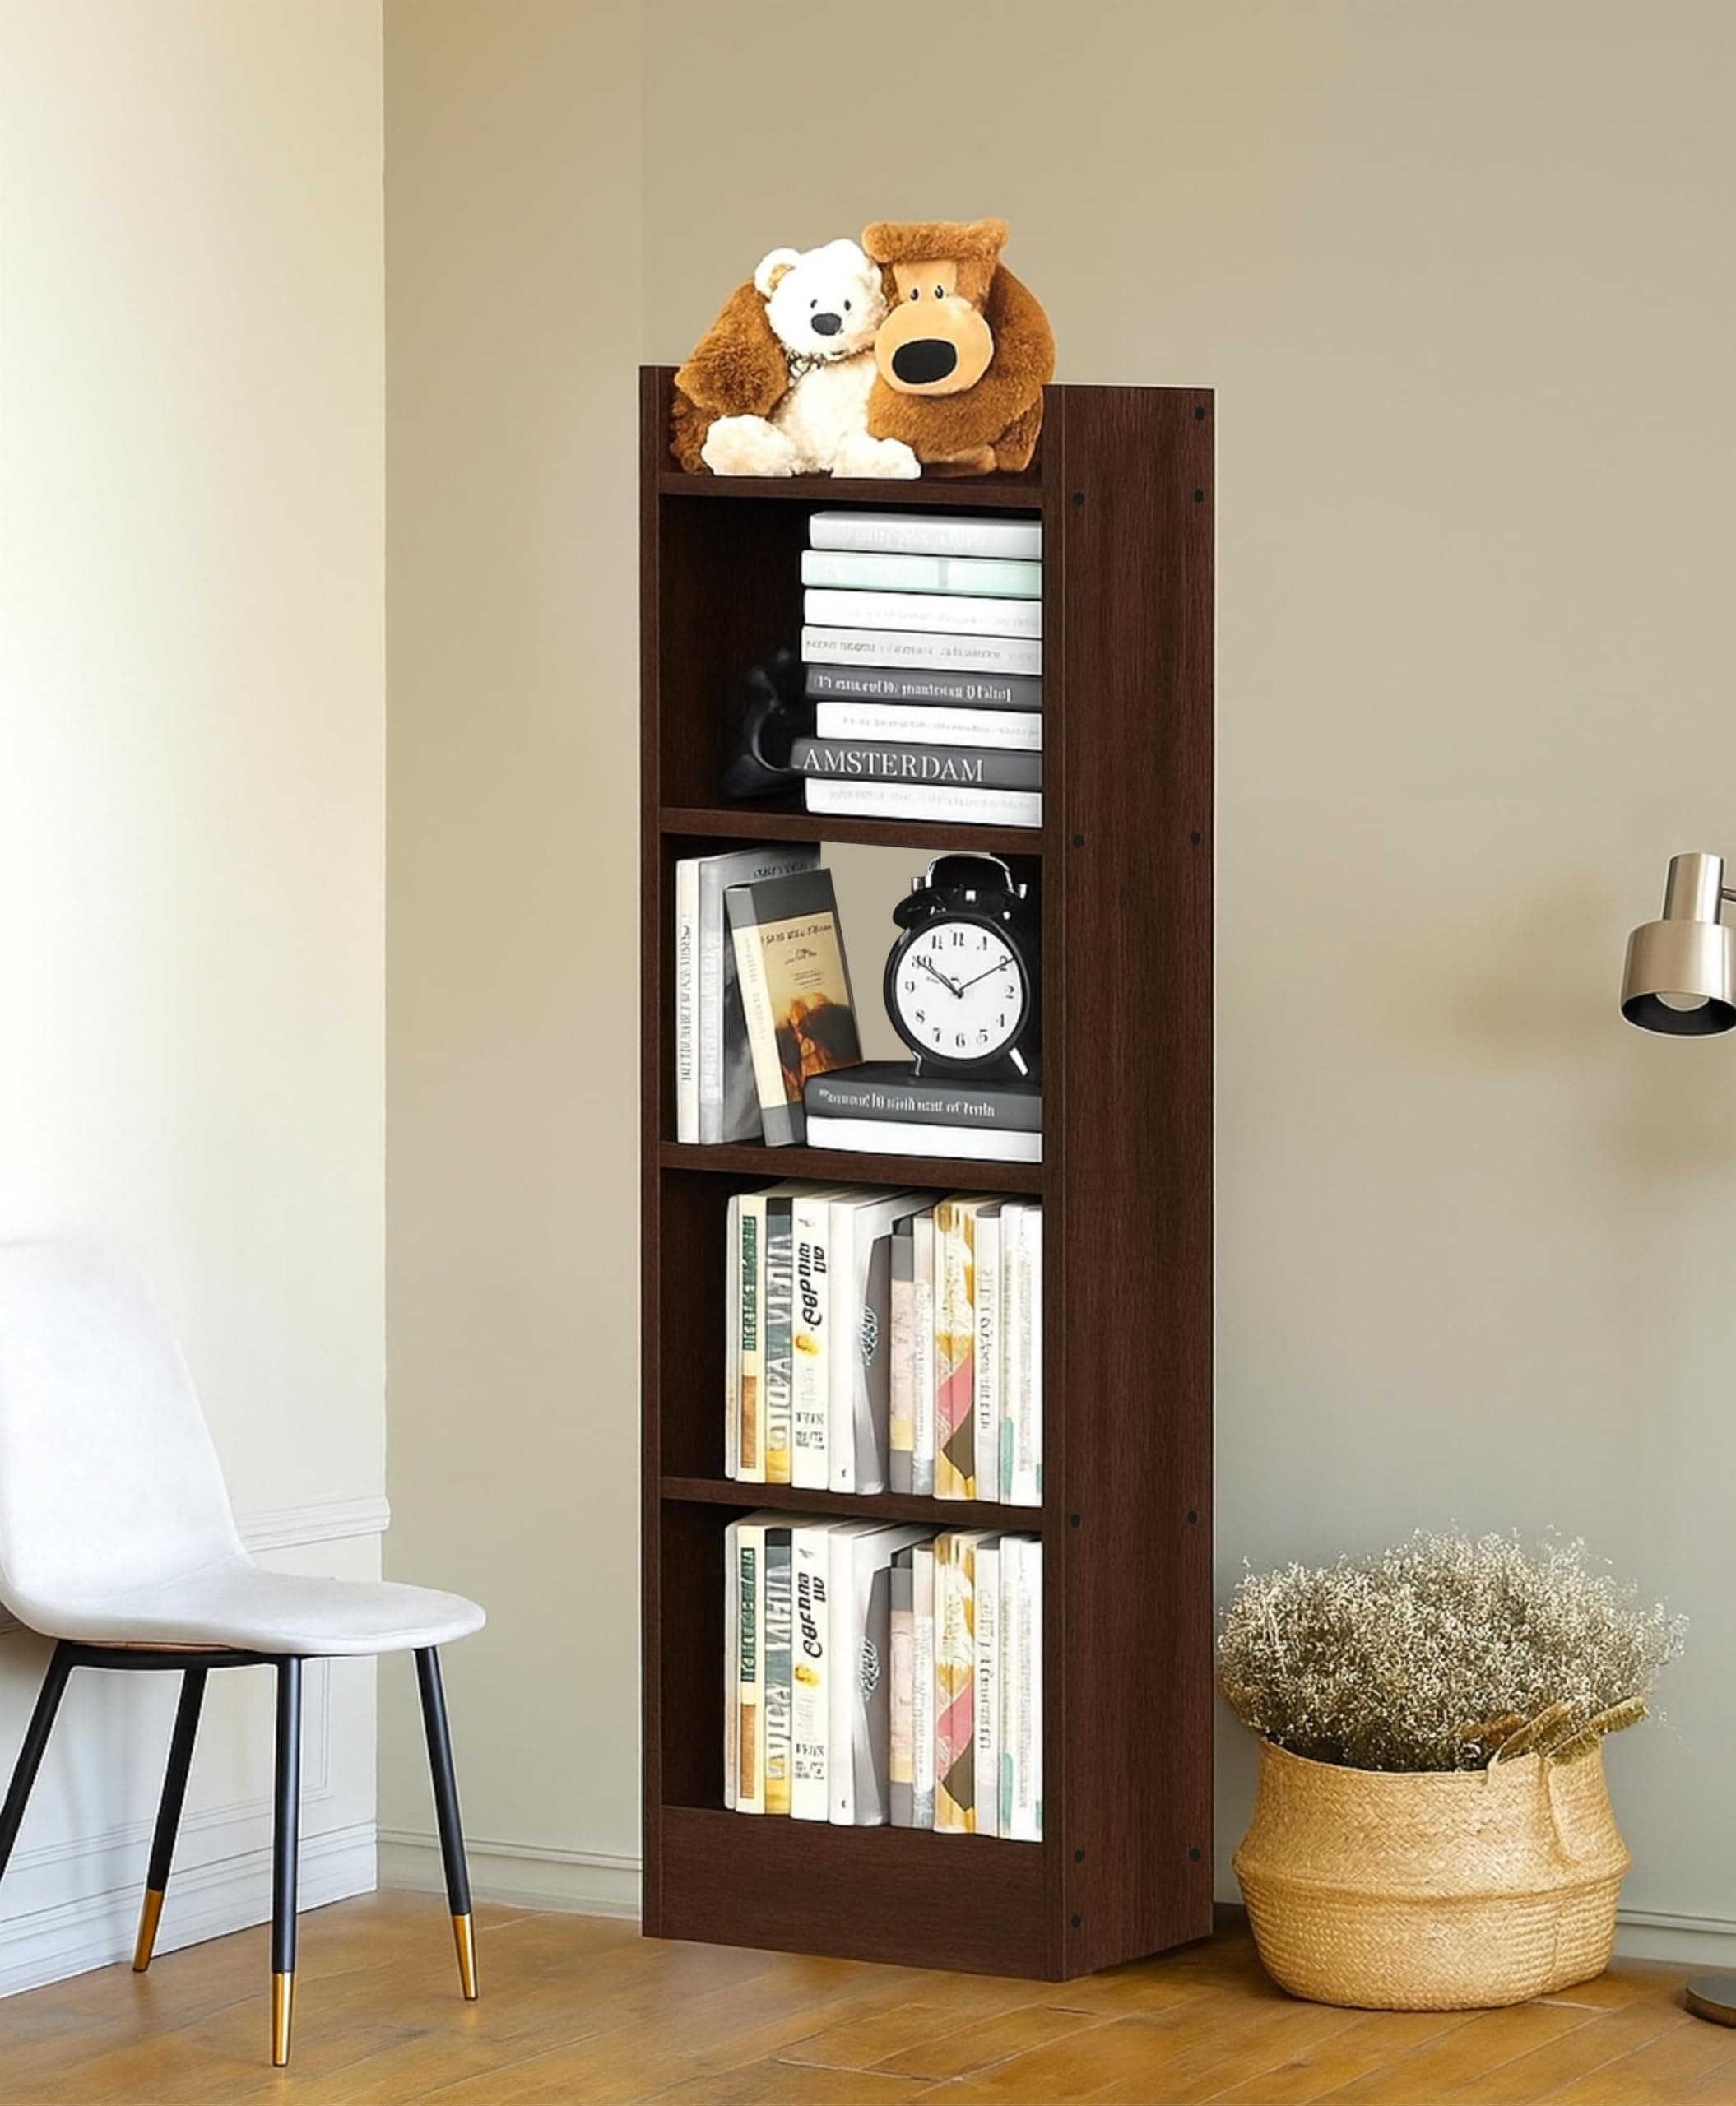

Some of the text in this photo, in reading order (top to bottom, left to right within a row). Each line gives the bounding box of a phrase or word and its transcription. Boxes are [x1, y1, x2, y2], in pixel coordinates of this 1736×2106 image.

[803, 748, 984, 782] AMSTERDAM
[932, 1027, 941, 1043] 7
[955, 1033, 966, 1047] 6
